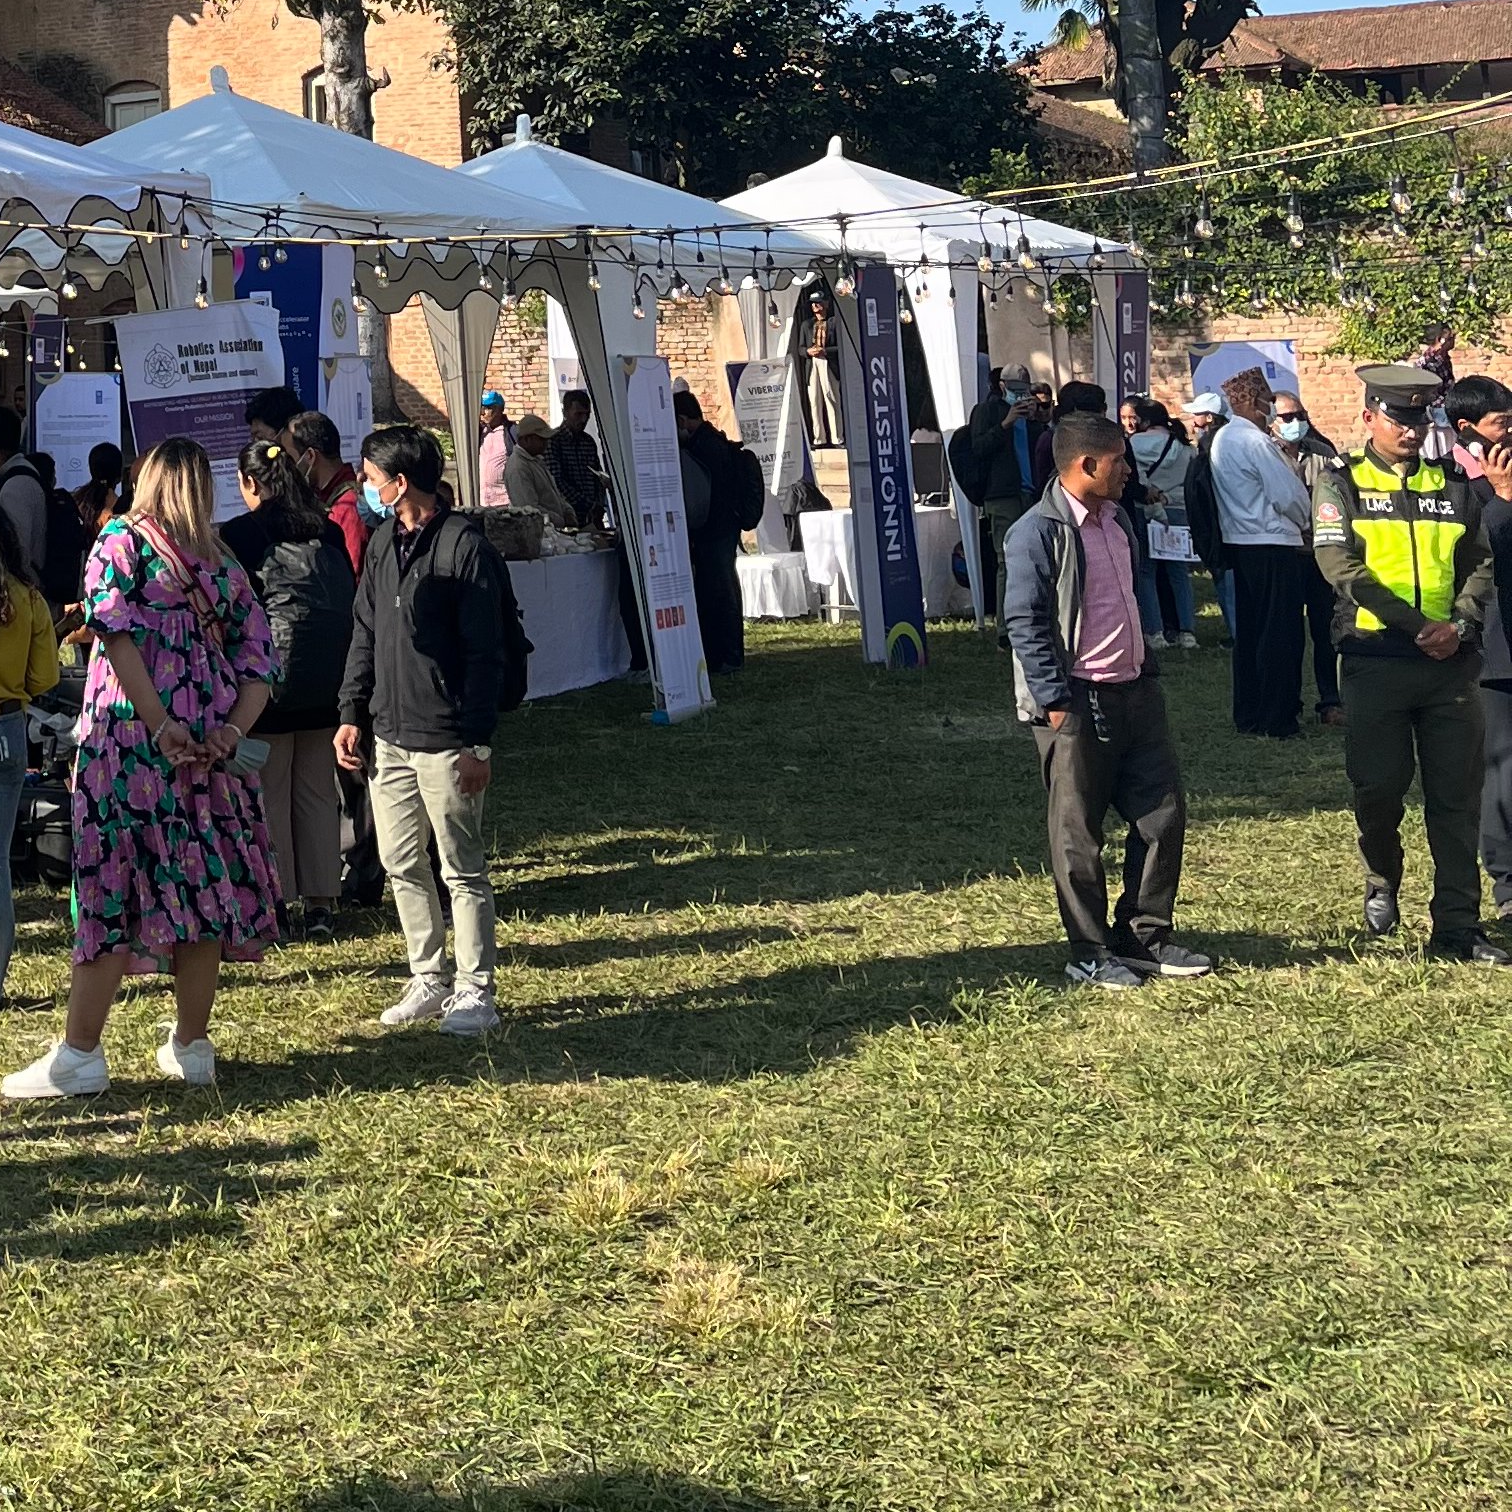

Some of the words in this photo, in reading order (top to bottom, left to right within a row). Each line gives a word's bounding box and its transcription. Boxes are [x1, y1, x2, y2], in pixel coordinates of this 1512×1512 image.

[177, 342, 215, 358] Robotics
[219, 338, 264, 354] Association
[180, 363, 188, 374] of
[193, 358, 218, 374] Nepal
[1366, 497, 1394, 513] LMC
